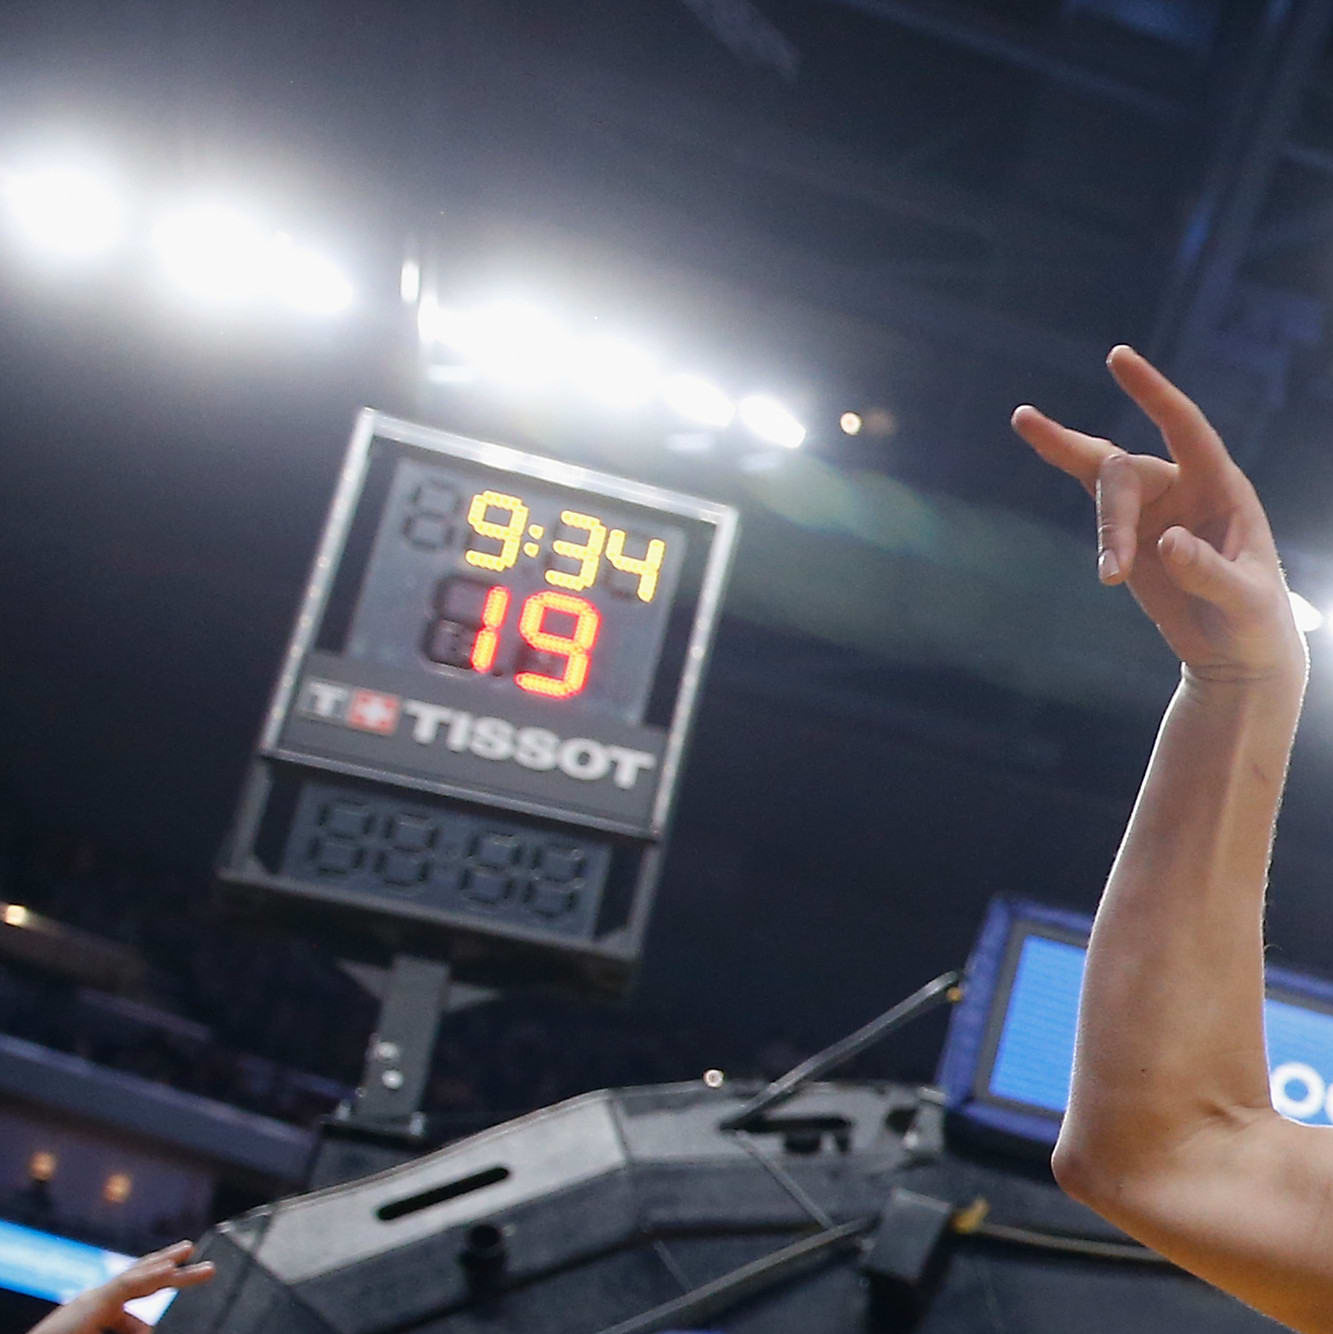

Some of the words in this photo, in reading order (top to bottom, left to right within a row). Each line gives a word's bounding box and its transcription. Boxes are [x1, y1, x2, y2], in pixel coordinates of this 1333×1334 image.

[465, 490, 667, 603] 9:34
[469, 585, 602, 699] 19
[404, 699, 657, 791] TISSOT
